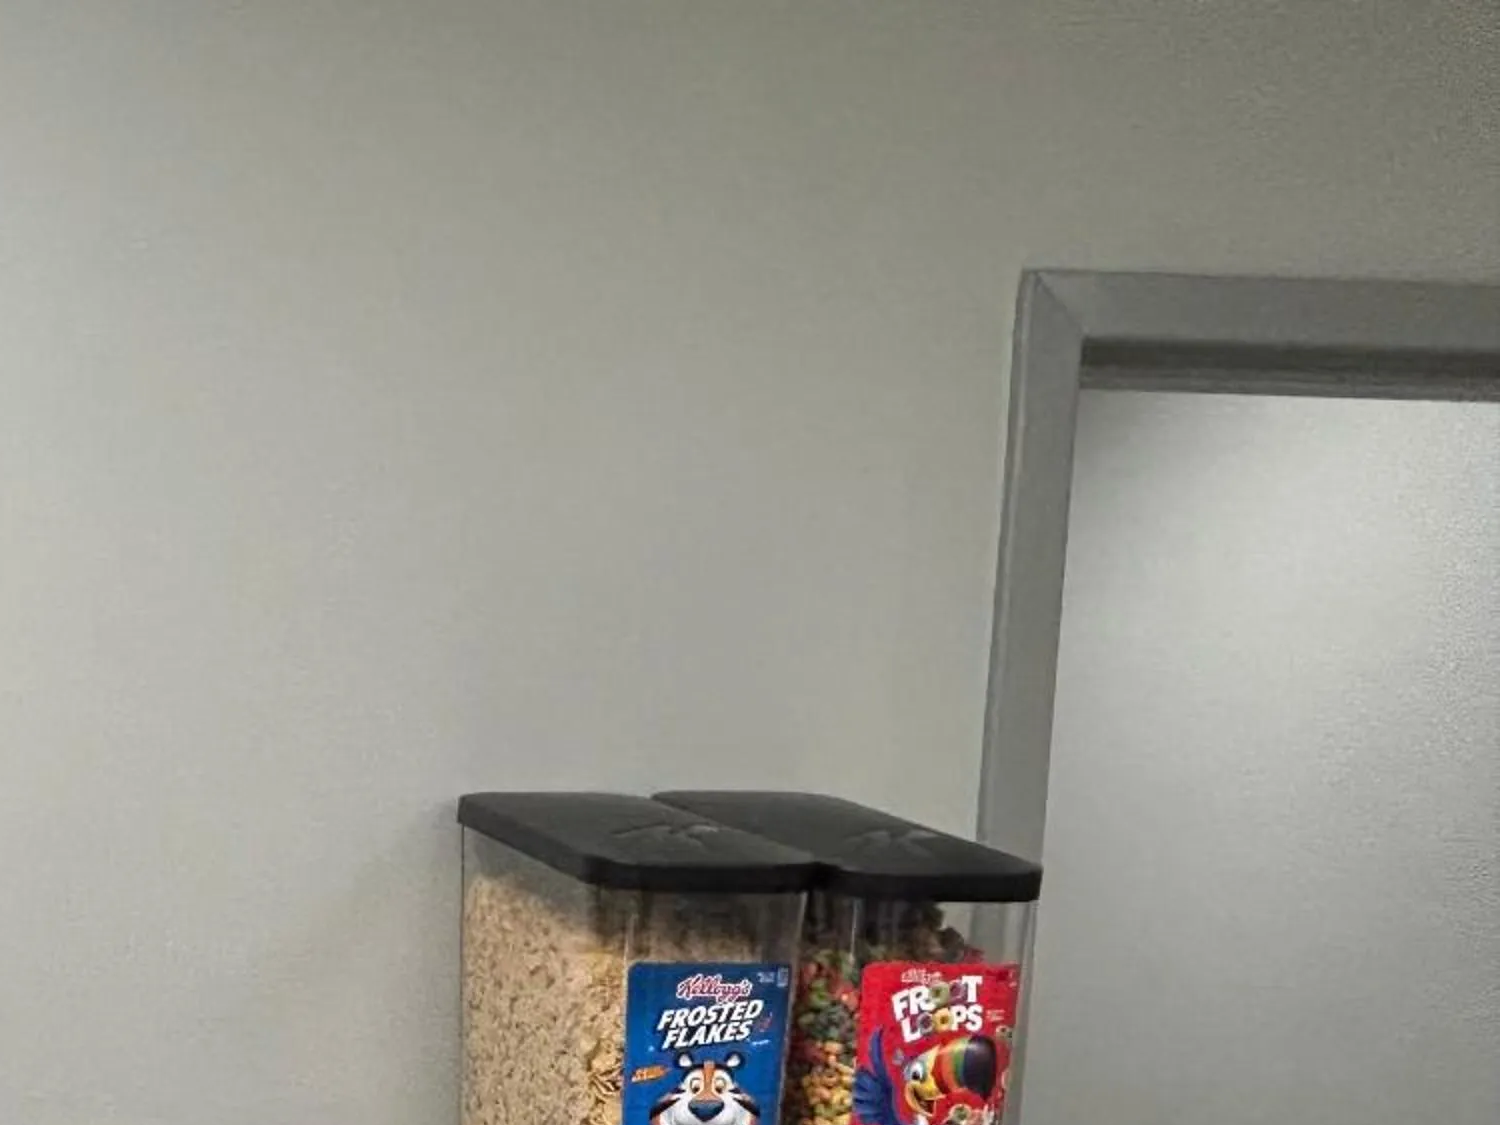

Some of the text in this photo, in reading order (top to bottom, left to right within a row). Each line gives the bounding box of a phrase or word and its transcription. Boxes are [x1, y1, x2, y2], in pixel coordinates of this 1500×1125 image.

[676, 974, 752, 1004] Kellogg's
[892, 975, 983, 1022] FROOT
[657, 1000, 764, 1030] FROSTED
[901, 1004, 983, 1042] LOOPS
[662, 1020, 752, 1049] FLAKES
